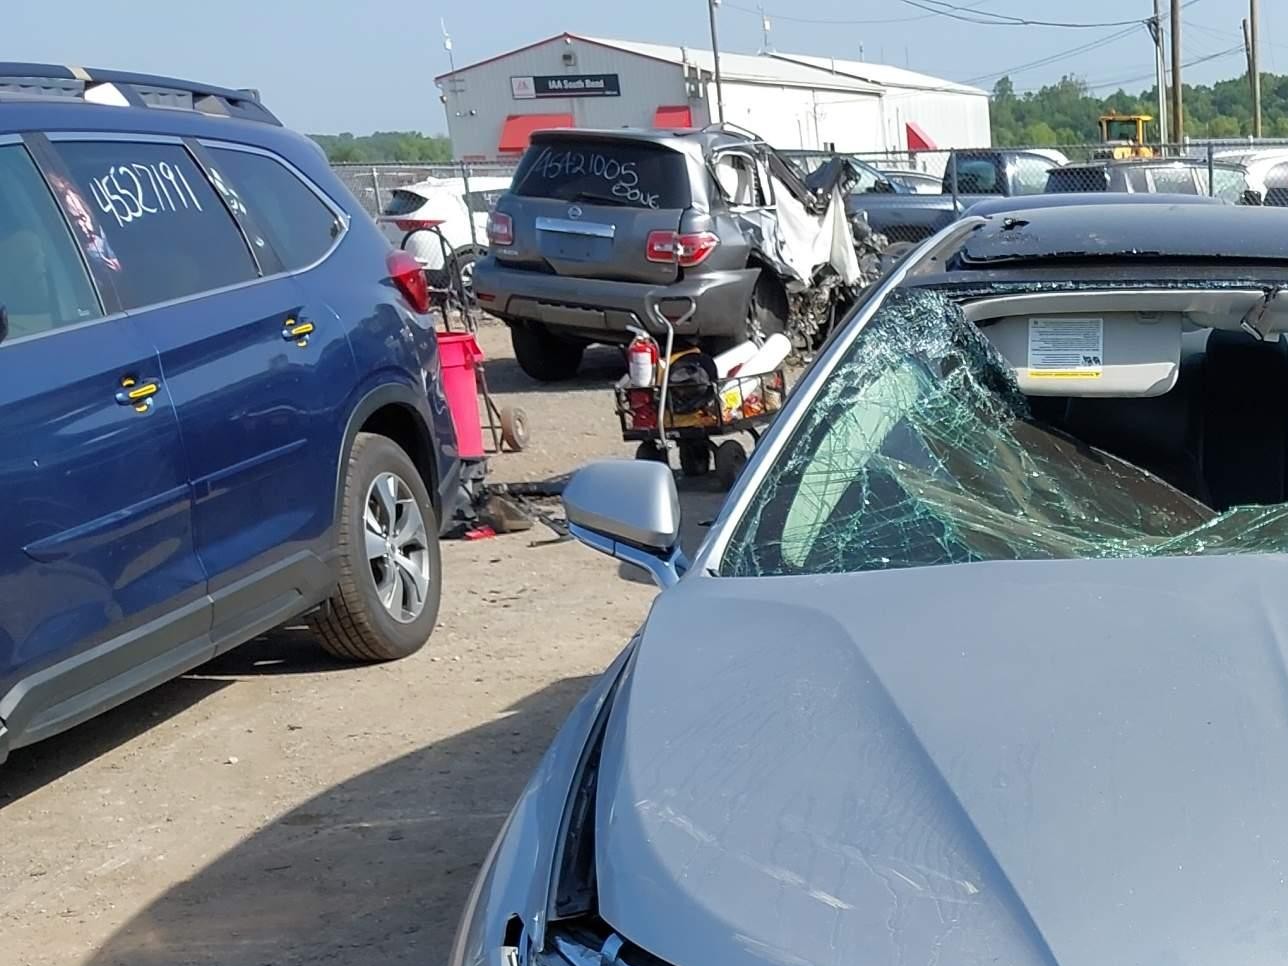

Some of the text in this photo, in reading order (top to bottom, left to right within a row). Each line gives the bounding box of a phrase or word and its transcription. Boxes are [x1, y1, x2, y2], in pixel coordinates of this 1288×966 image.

[548, 79, 604, 89] IAA South Bend
[89, 161, 203, 228] 45527191
